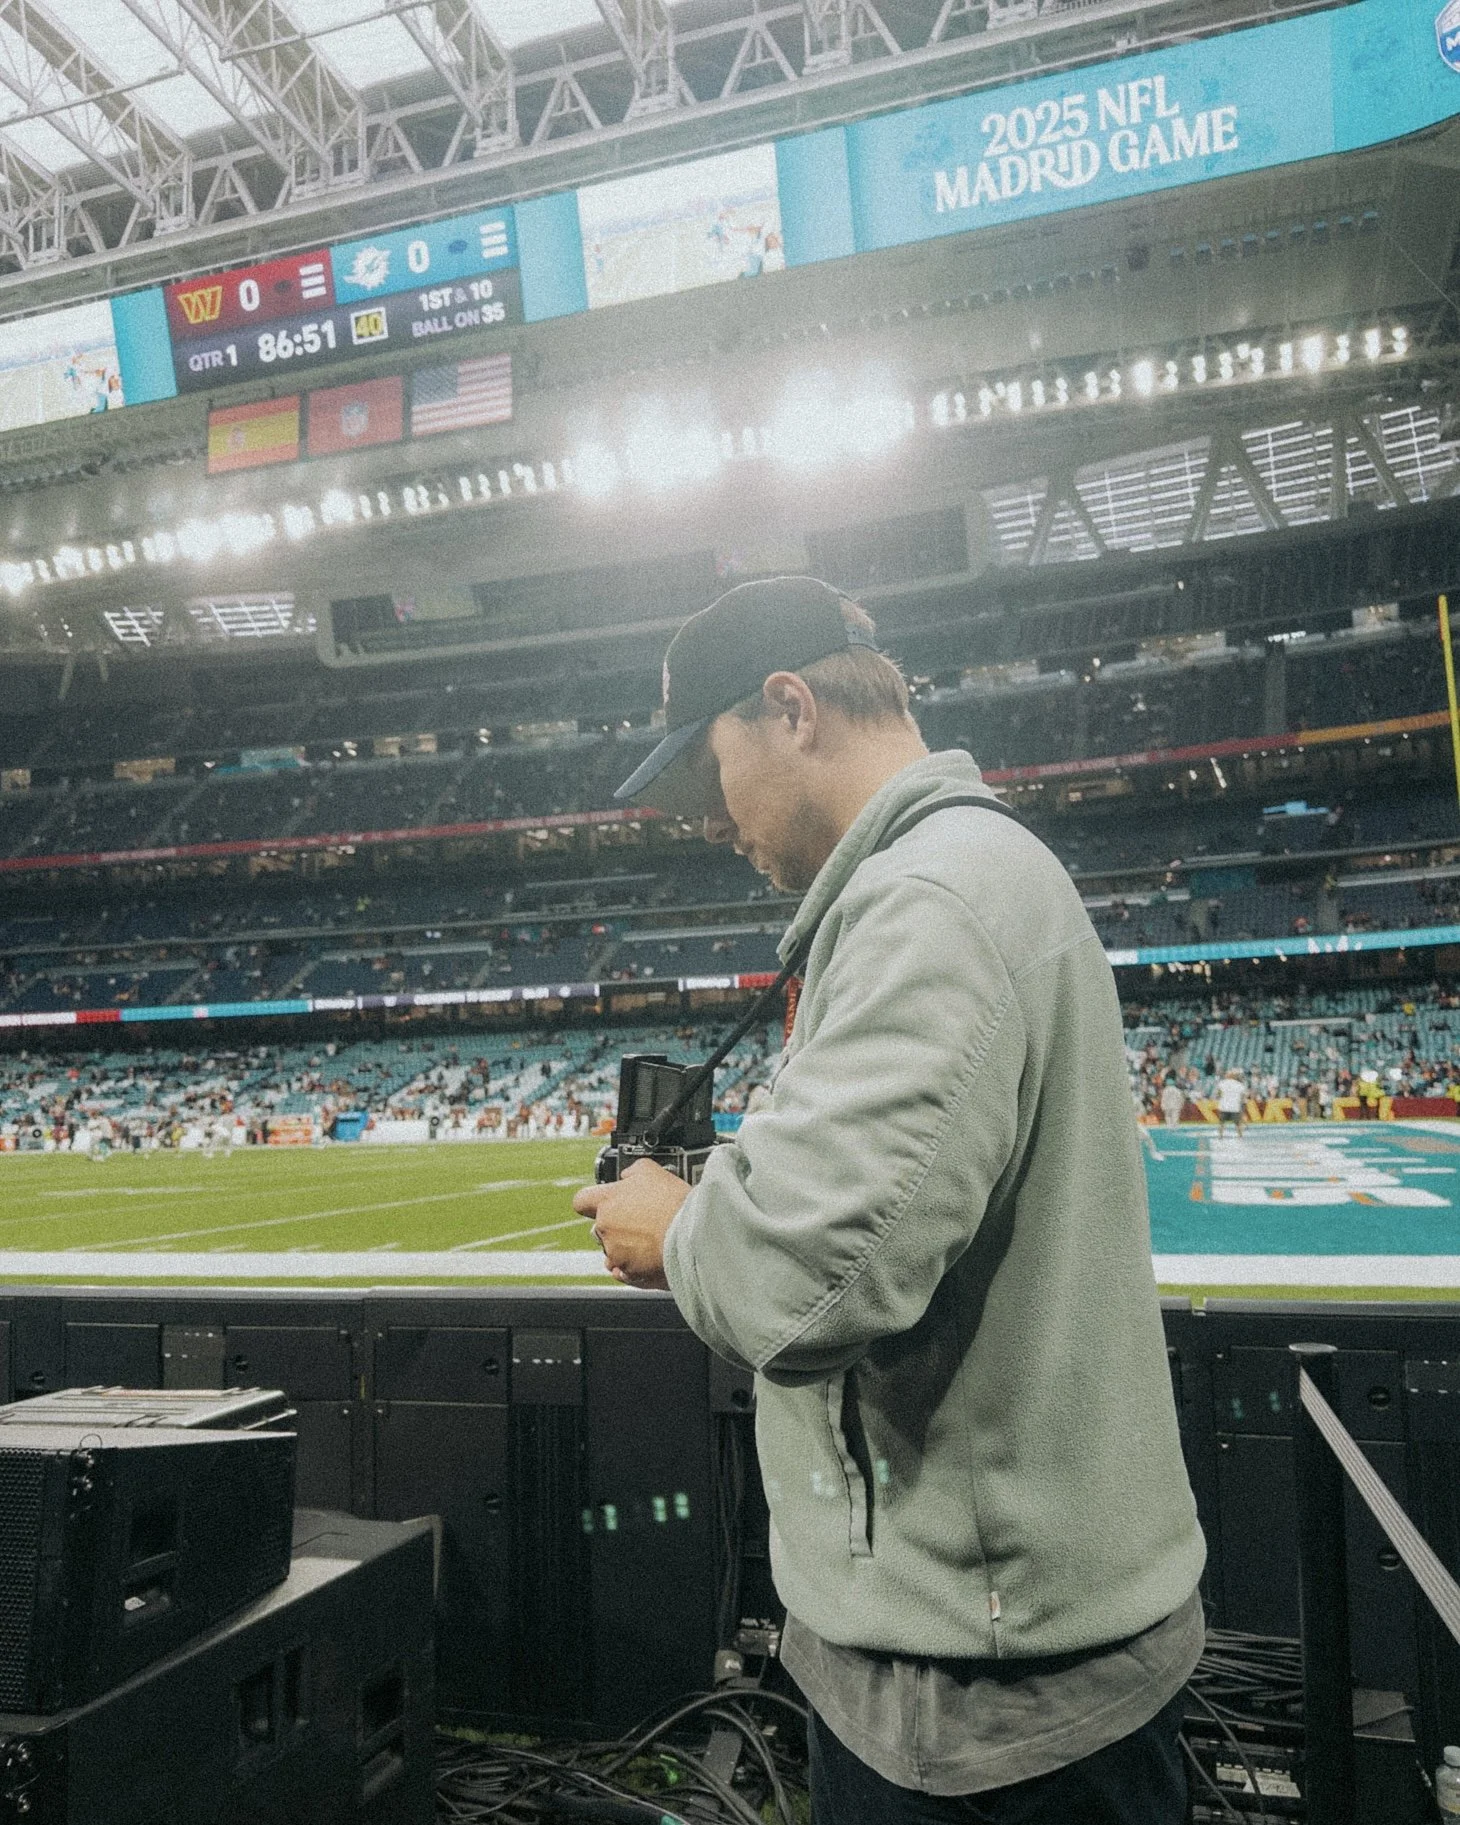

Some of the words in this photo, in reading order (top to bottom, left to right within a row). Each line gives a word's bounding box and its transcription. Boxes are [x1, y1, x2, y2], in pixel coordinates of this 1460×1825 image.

[980, 93, 1090, 157] 2025
[1096, 75, 1180, 131] NFL
[933, 139, 1101, 213] MADRID
[1108, 104, 1239, 173] GAME
[407, 240, 430, 273] 0
[239, 279, 260, 311] 0
[419, 287, 453, 311] 1ST
[469, 279, 493, 300] 10
[354, 313, 383, 338] 40
[411, 316, 453, 338] BALL
[454, 308, 481, 328] ON
[258, 319, 337, 363] 86:51
[188, 350, 224, 372] QTR
[226, 344, 238, 366] 1
